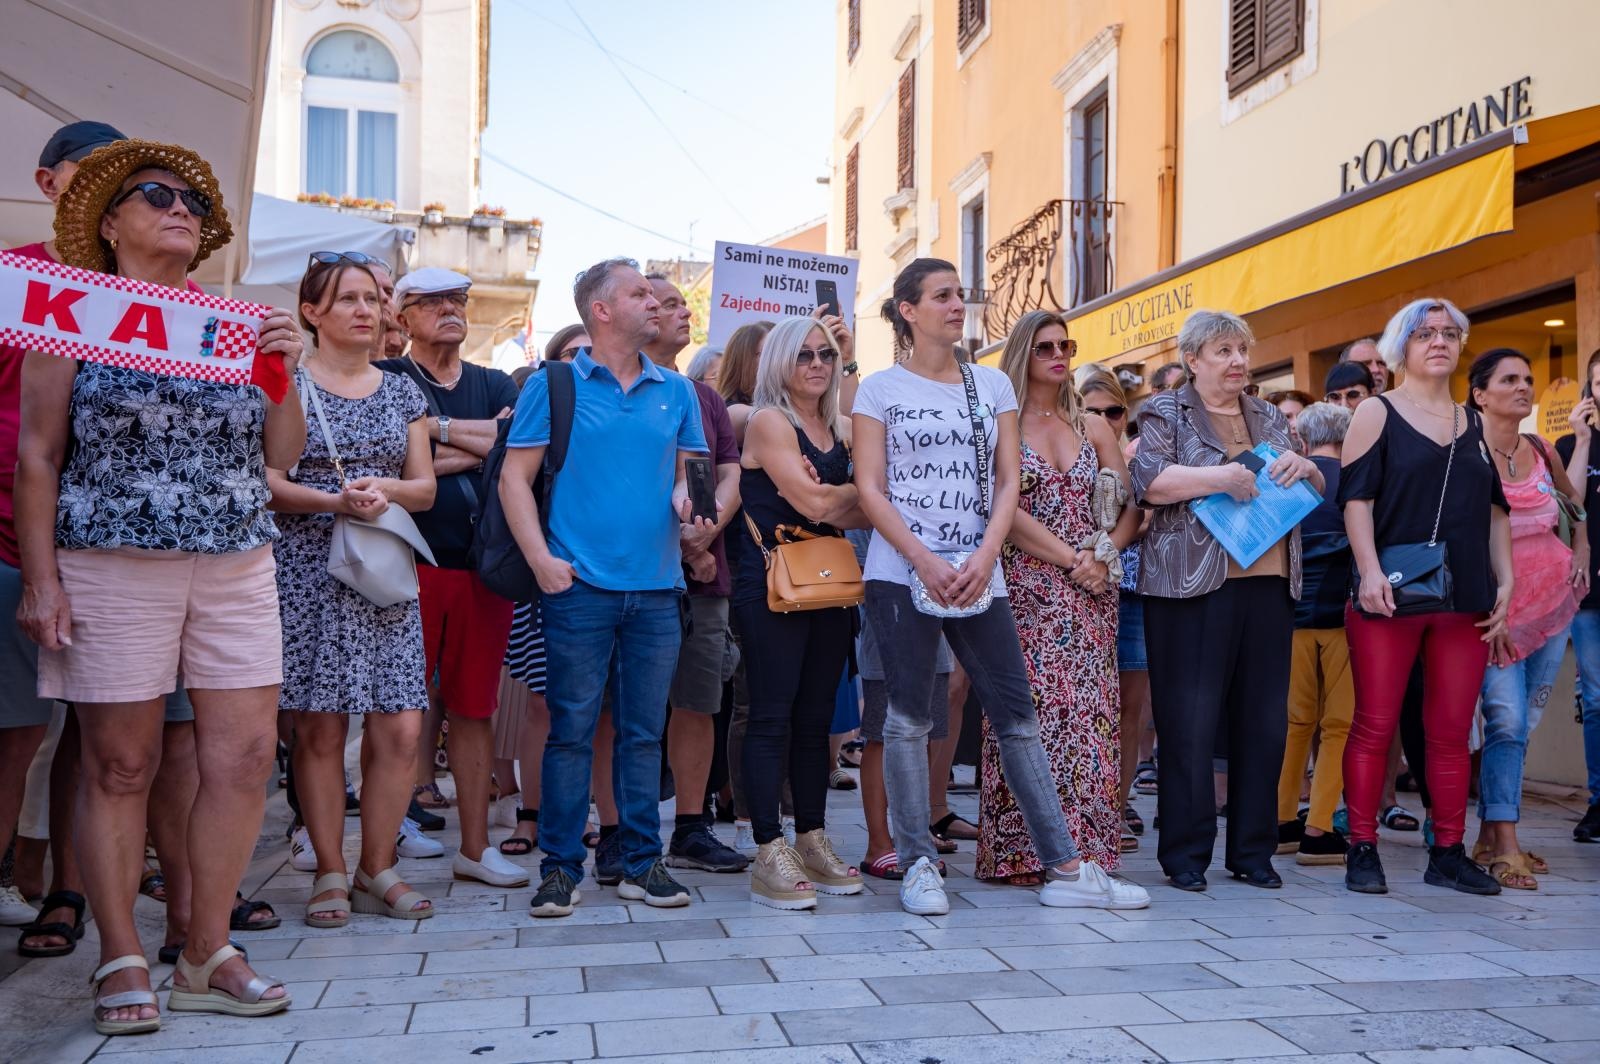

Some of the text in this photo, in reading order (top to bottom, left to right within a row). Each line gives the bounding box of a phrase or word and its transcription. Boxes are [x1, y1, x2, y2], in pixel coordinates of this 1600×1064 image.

[1339, 76, 1533, 197] L'OCCITANE
[724, 246, 849, 275] Sami ne možemo
[763, 274, 809, 294] NIŠTA!
[720, 294, 781, 313] Zajedno
[1110, 282, 1193, 336] L'OCCITANE
[960, 363, 974, 391] CHANGE
[975, 428, 987, 471] CHANGE
[980, 472, 989, 480] A
[980, 480, 990, 511] MAKE
